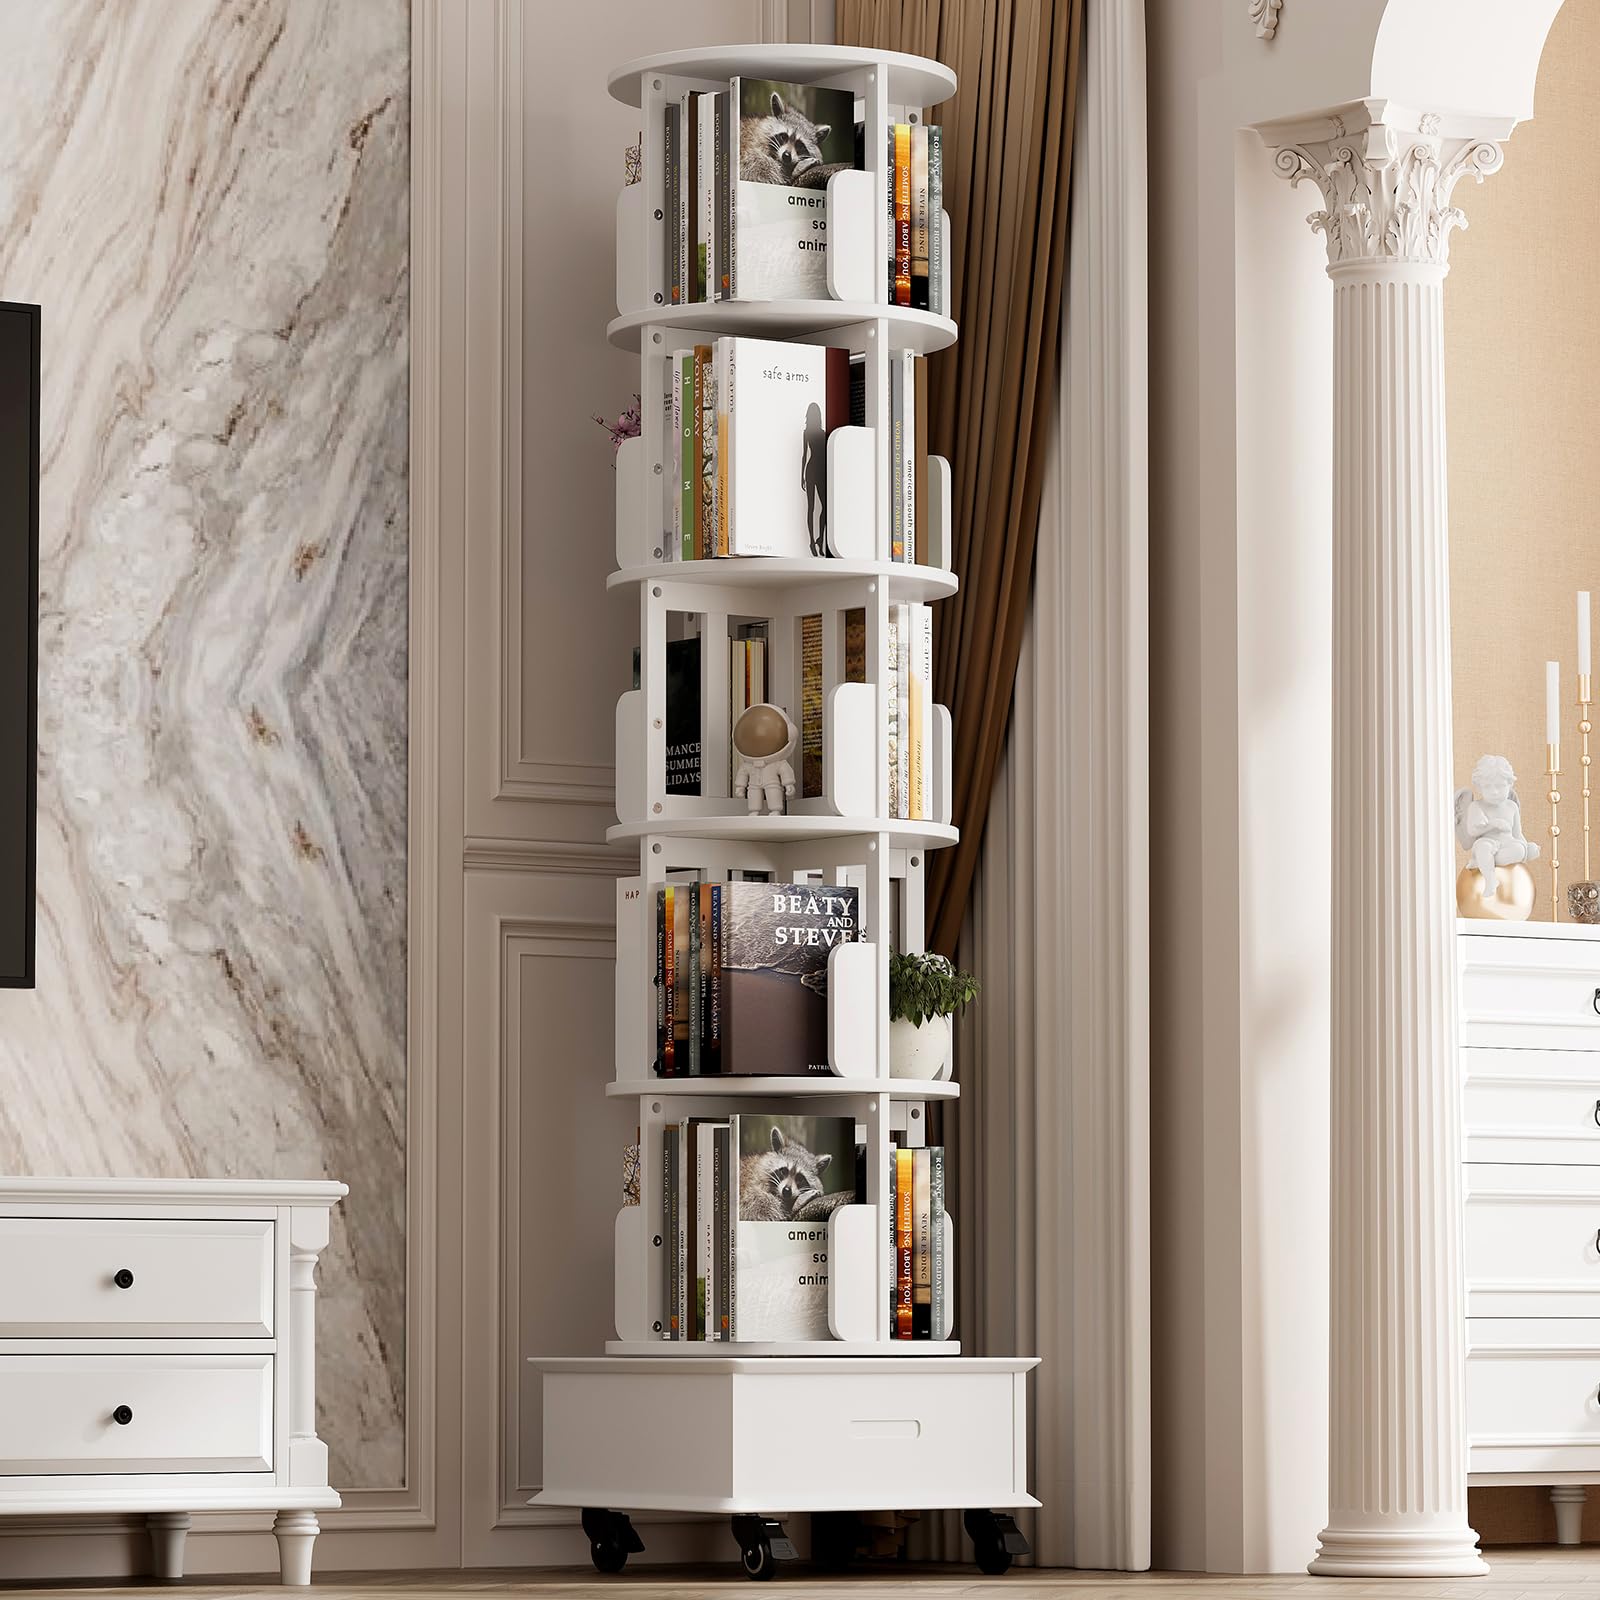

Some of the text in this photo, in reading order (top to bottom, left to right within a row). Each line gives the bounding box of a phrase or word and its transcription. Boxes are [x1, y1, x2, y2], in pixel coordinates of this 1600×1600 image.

[715, 140, 720, 151] OF
[665, 153, 671, 164] OF
[788, 195, 827, 208] ameri
[763, 365, 809, 382] safe arms
[895, 453, 901, 464] OF
[625, 890, 640, 900] HAP
[772, 894, 853, 916] BEATY
[826, 916, 853, 927] AND
[775, 927, 853, 946] STEVE
[713, 976, 718, 990] ON
[664, 1177, 669, 1188] OF
[715, 1176, 719, 1186] OF
